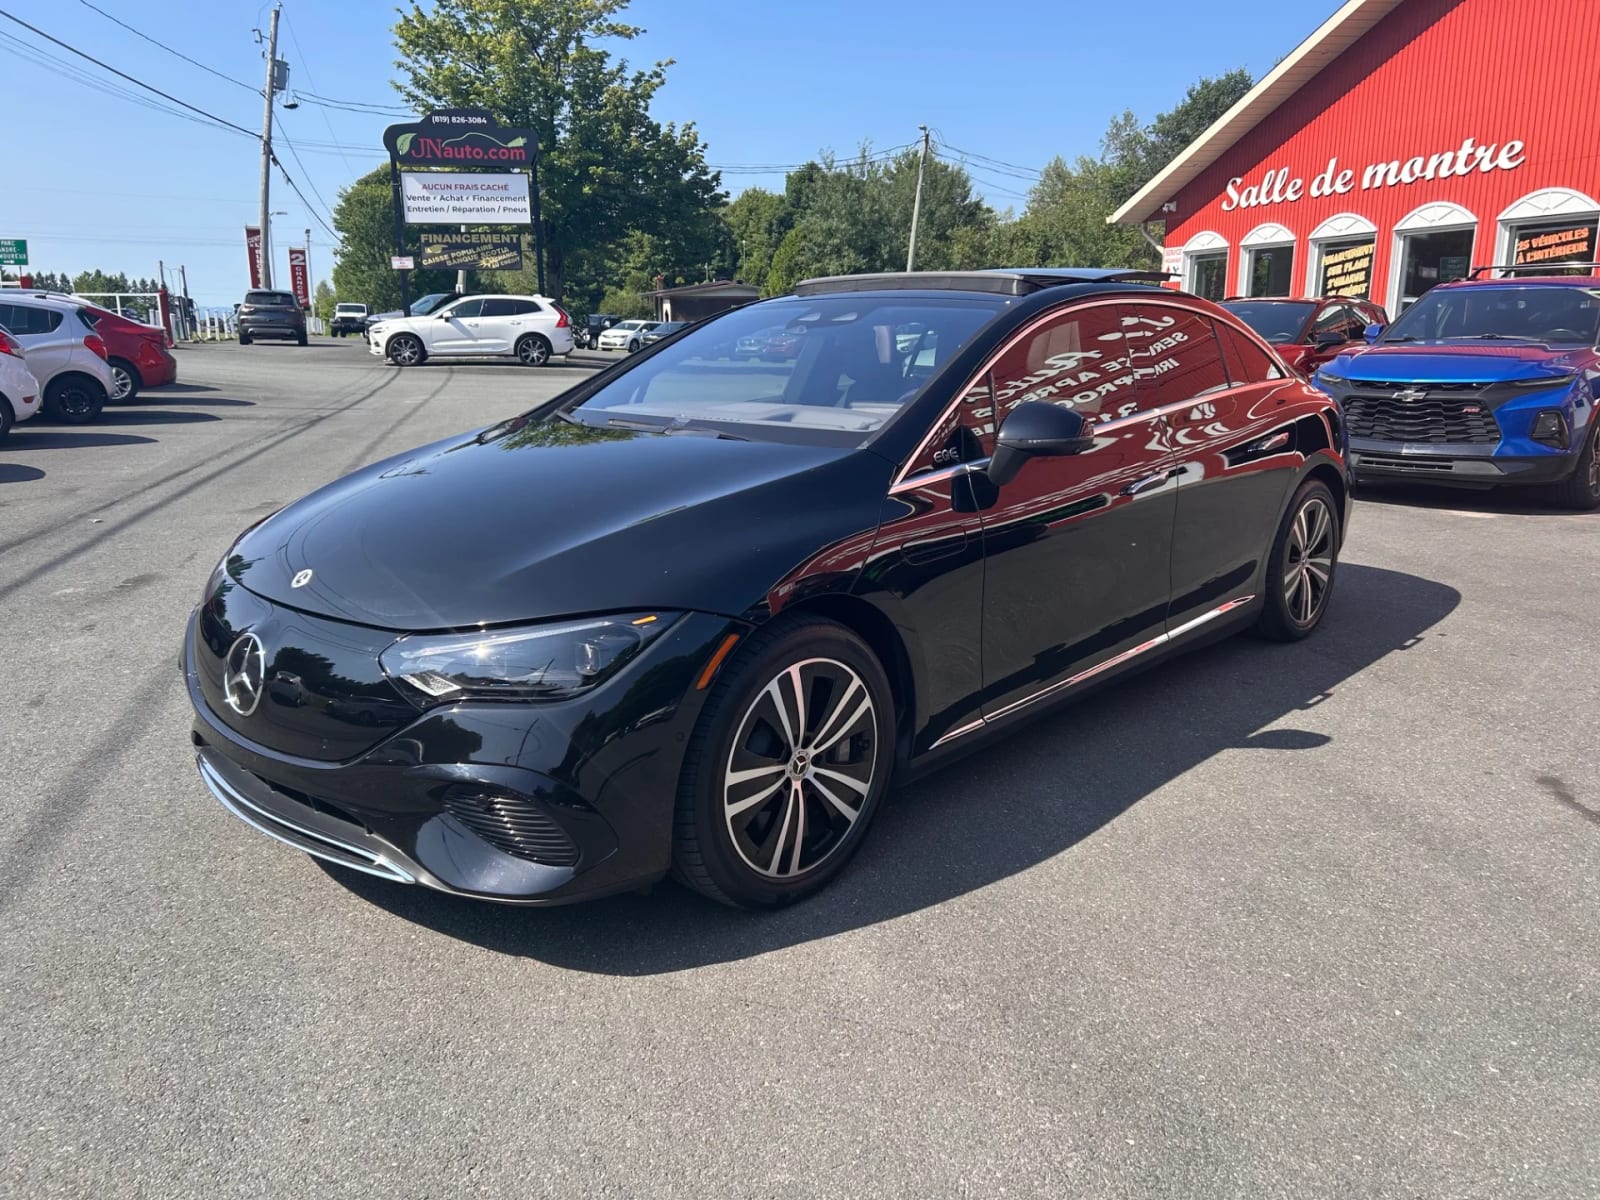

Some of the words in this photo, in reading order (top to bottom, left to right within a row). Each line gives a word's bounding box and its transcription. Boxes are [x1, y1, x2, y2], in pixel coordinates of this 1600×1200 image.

[432, 116, 450, 124] (819)
[451, 116, 488, 124] 826-3084
[411, 138, 526, 160] JNauto.com
[1221, 166, 1304, 212] Salle
[1310, 157, 1356, 198] de
[1361, 136, 1526, 190] montre
[422, 183, 453, 191] AUCUN
[406, 194, 431, 202] Vente
[439, 194, 464, 202] Achat
[472, 194, 527, 203] Financement
[407, 205, 445, 213] Entretien
[452, 205, 496, 214] Réparation
[502, 206, 528, 214] Pneus
[420, 234, 519, 244] FINANCEMENT
[1517, 239, 1530, 252] 25
[1531, 227, 1590, 248] VÉHICULES
[291, 253, 305, 266] 2
[422, 254, 450, 266] CAISSE
[450, 244, 494, 258] POPULAIRE
[446, 254, 479, 266] BANQUE
[480, 246, 510, 259] SCOTIA
[934, 446, 960, 462] EQE
